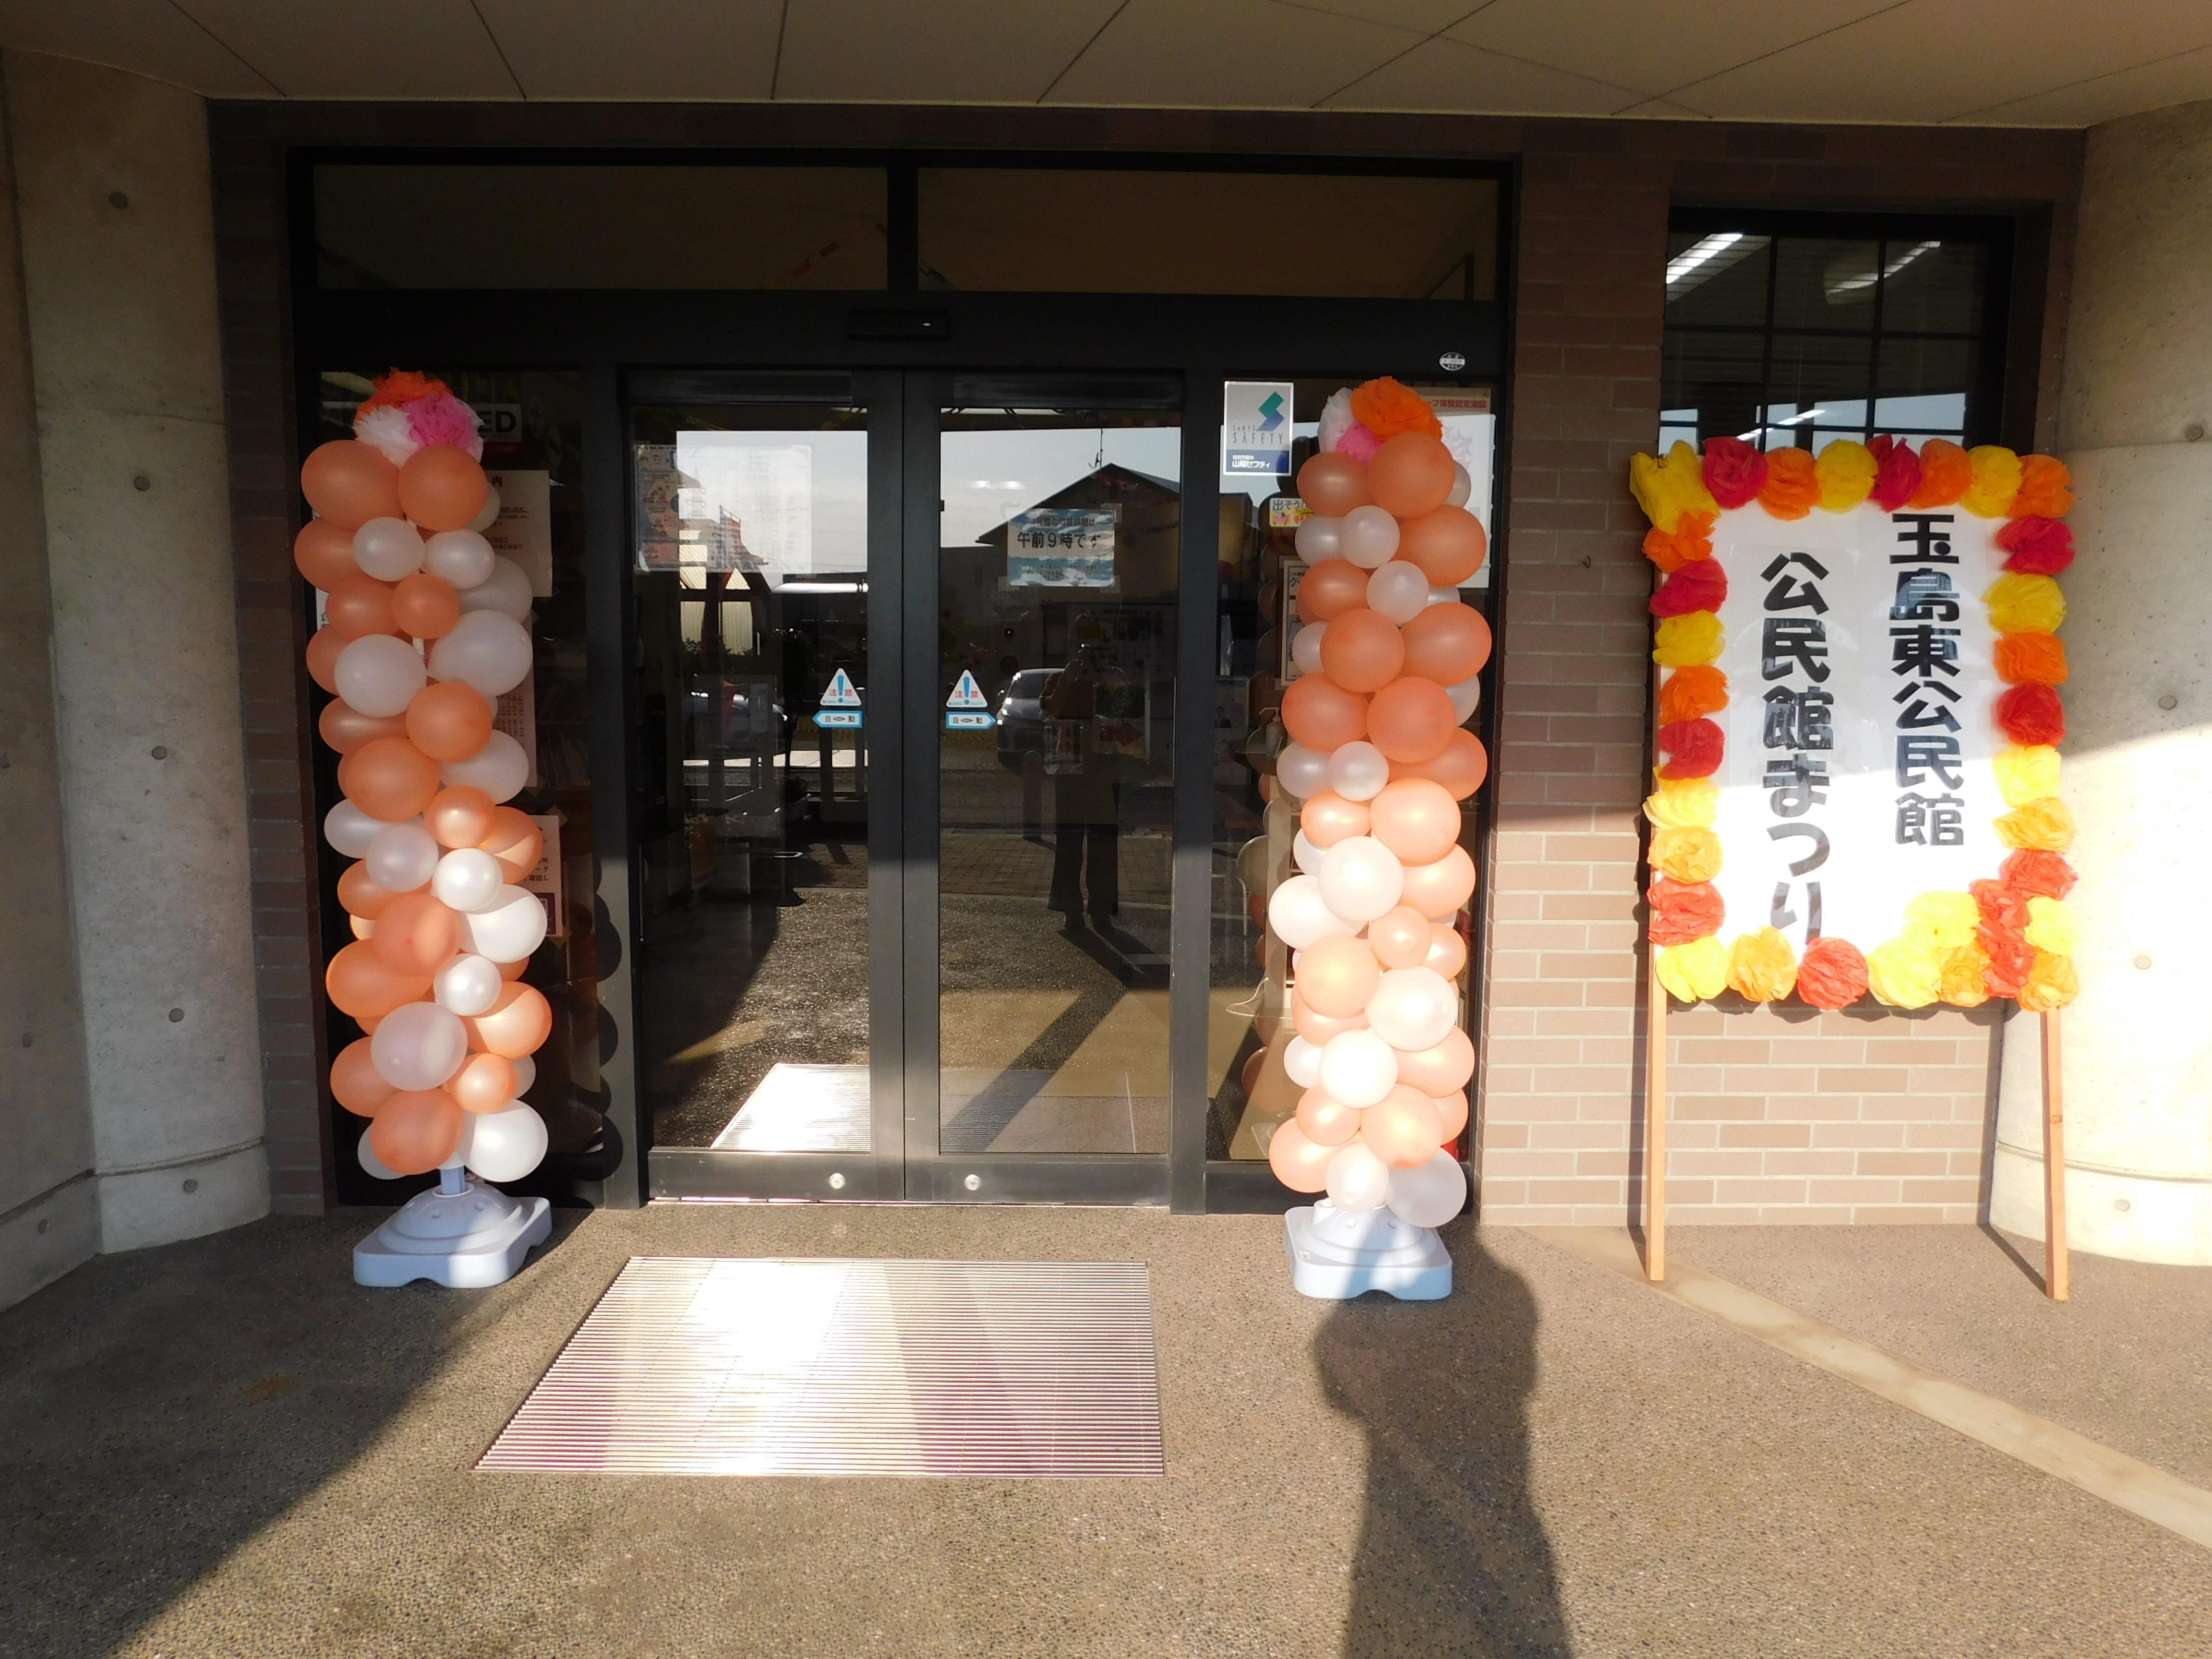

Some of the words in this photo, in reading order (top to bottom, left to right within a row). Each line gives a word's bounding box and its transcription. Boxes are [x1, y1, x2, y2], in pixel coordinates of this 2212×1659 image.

[1233, 432, 1283, 444] SAFETY
[1760, 552, 1834, 946] 公民館まつり
[1888, 513, 1965, 846] 玉島東公民館
